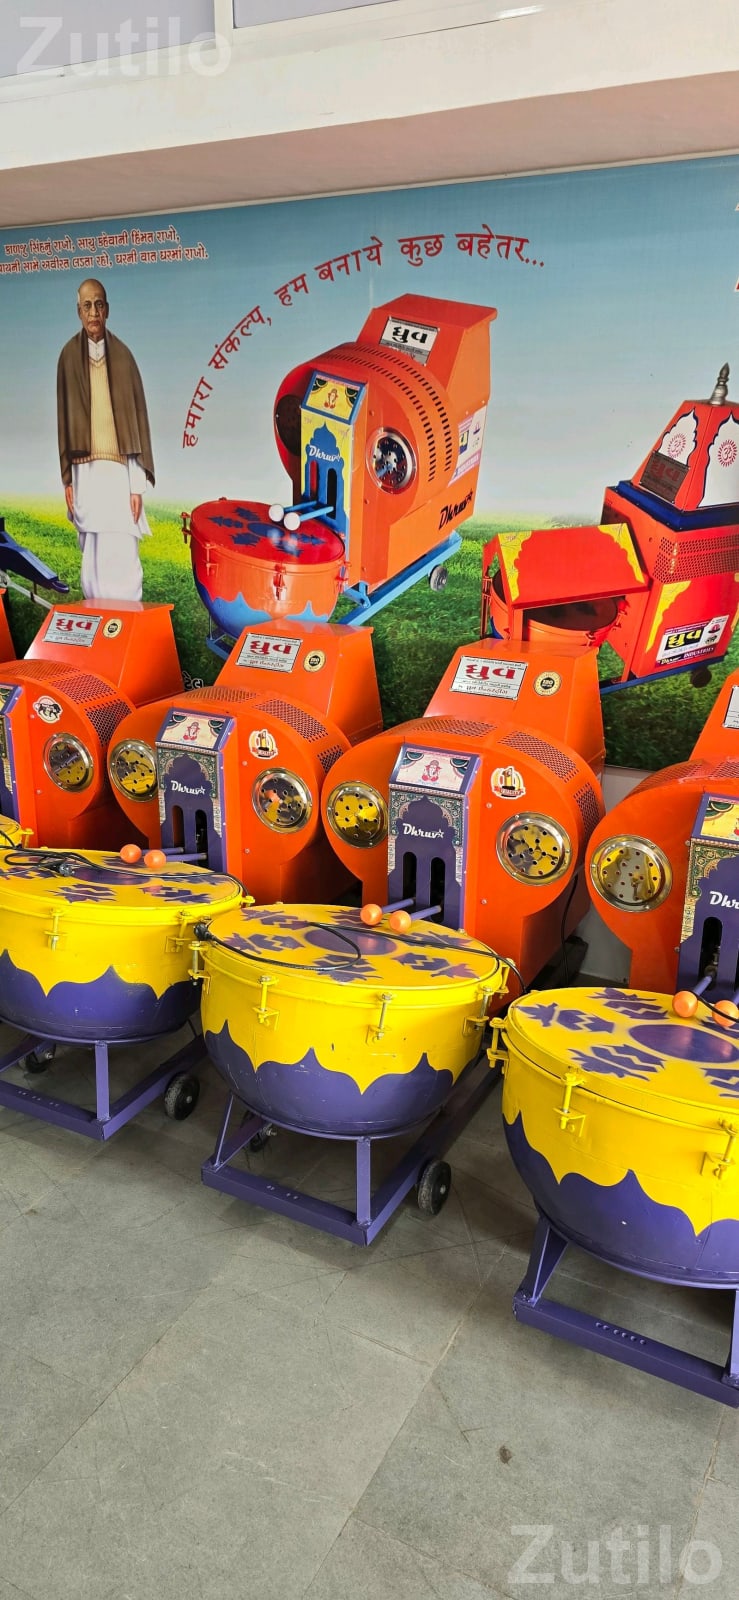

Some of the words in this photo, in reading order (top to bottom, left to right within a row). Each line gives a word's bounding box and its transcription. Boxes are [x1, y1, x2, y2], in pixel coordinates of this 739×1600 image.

[182, 376, 213, 448] हमारा
[208, 305, 272, 370] संकल्प,
[273, 273, 309, 306] हम
[314, 235, 384, 281] बनाये
[398, 233, 445, 267] कुछ
[170, 780, 201, 795] Dhruv
[402, 823, 438, 838] Dhruv
[709, 890, 739, 909] Dhr
